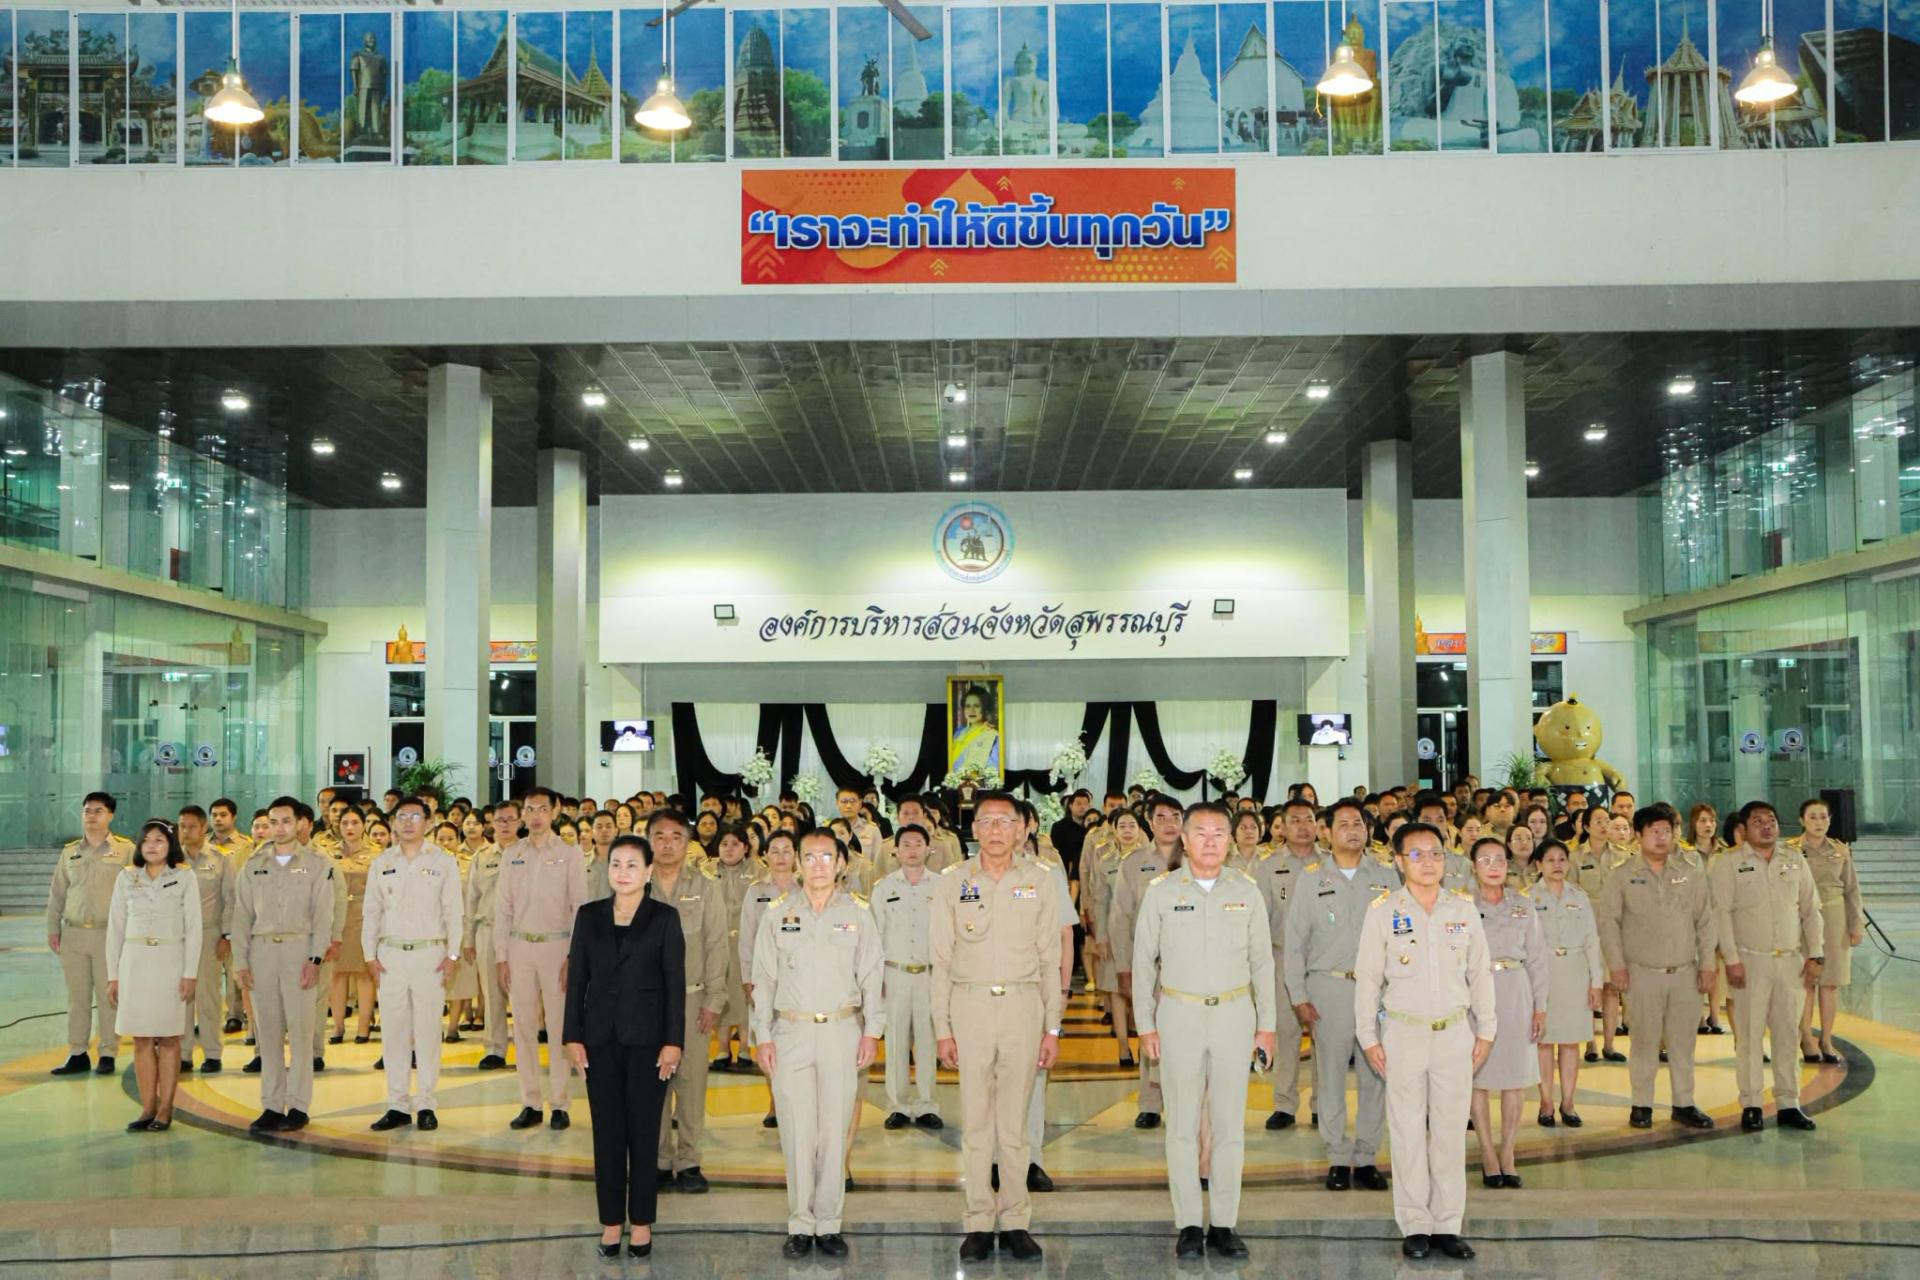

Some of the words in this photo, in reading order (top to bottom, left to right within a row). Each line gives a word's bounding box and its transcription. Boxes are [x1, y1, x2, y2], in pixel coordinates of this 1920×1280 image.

[748, 194, 1230, 260] “เราจะทำให้ดีขึ้นทุกวัน”
[759, 600, 1191, 651] องค์การบริหารส่วนจังหวัดสุพรรณบุรี
